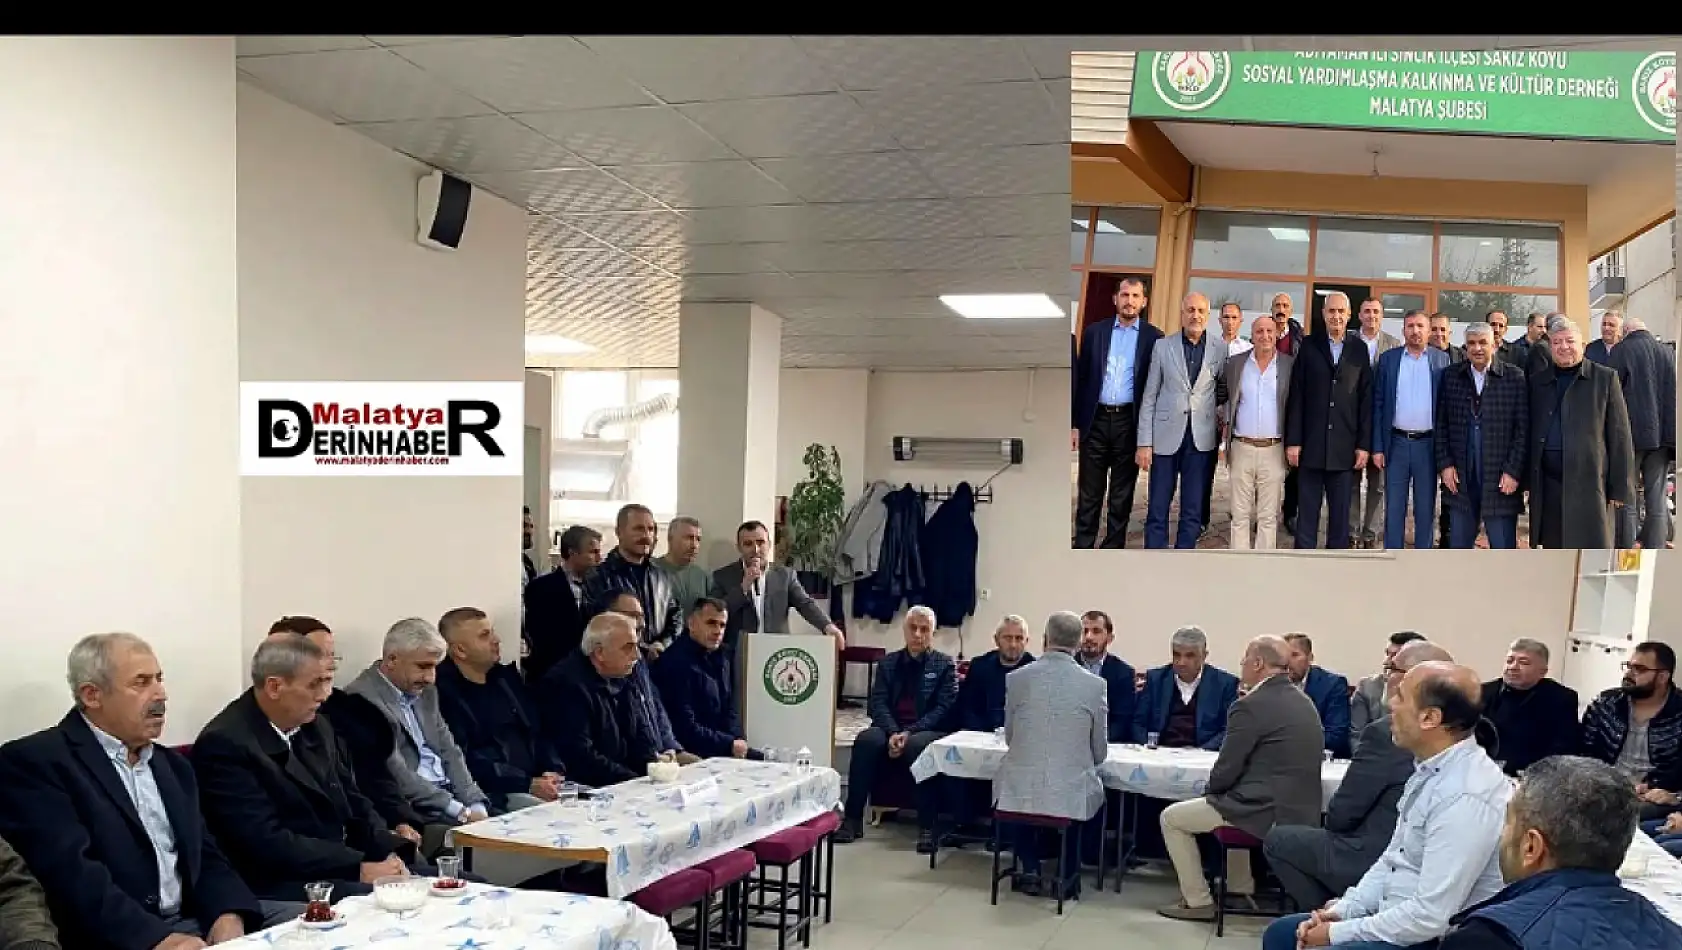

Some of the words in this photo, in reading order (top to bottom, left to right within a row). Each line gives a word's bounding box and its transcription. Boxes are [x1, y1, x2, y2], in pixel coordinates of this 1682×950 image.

[1483, 50, 1525, 67] SAKIZ
[1242, 64, 1294, 84] SOSYAL
[1297, 66, 1398, 90] YARDIMLAŞMA
[1400, 71, 1475, 92] KALKINMA
[1477, 73, 1497, 93] VE
[1500, 72, 1554, 96] KÜLTÜR
[1369, 96, 1434, 118] MALATYA
